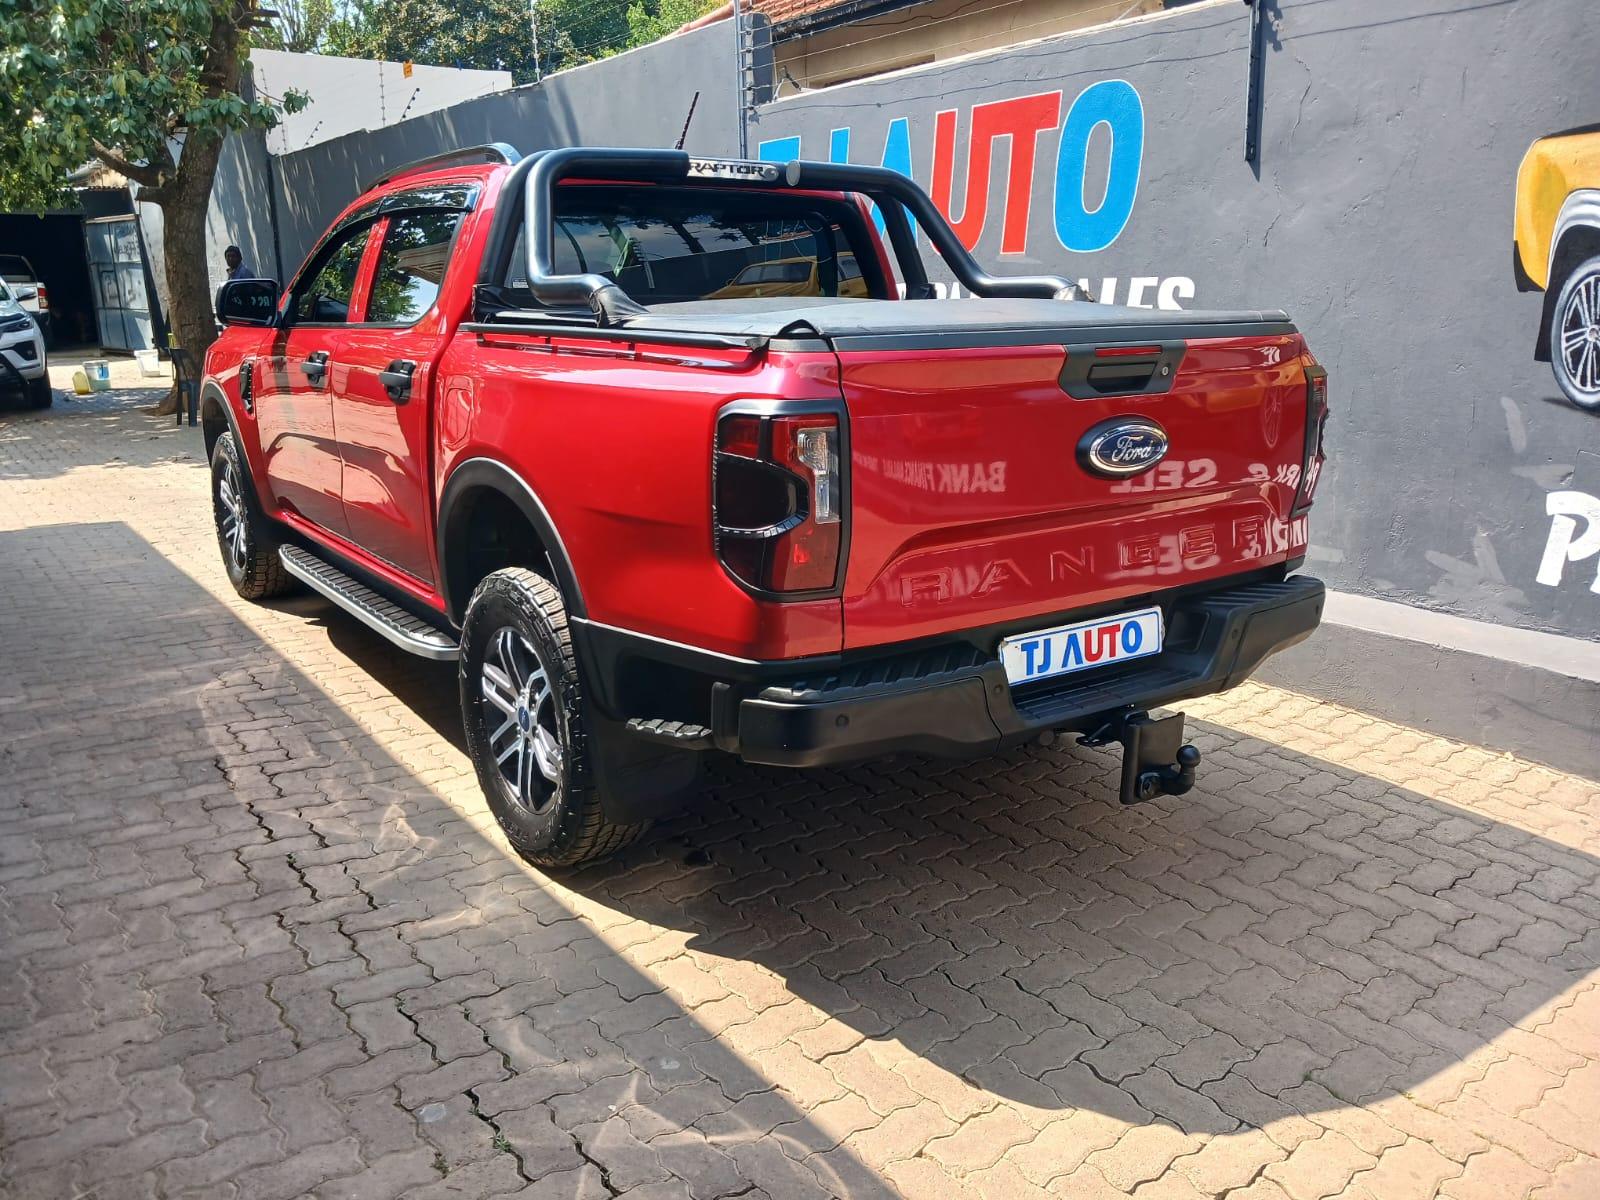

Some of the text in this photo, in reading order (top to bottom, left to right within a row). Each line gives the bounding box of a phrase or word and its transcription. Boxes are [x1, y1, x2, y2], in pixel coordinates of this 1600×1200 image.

[689, 161, 768, 178] RAPTOR
[868, 79, 1144, 255] AUTO
[1112, 435, 1155, 461] Ford
[901, 514, 1265, 608] RANGER
[1535, 490, 1600, 595] P
[1020, 620, 1143, 676] TJ AUTO
